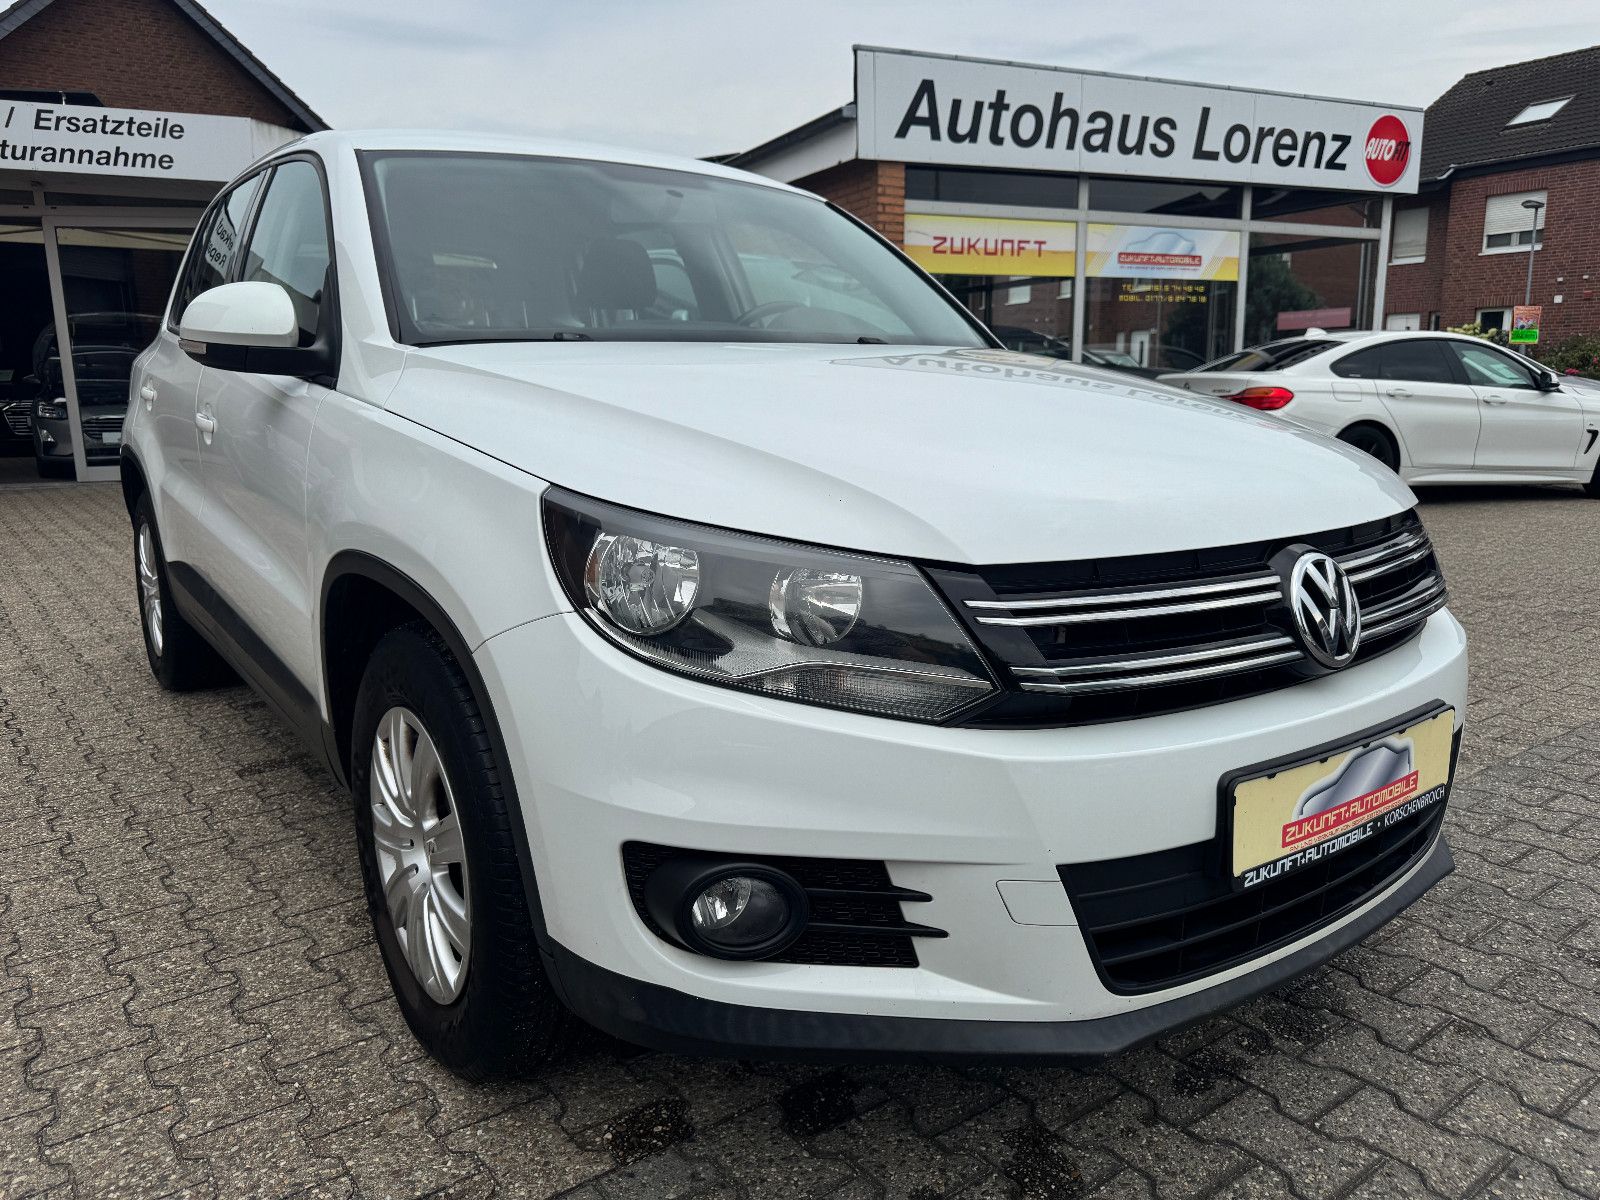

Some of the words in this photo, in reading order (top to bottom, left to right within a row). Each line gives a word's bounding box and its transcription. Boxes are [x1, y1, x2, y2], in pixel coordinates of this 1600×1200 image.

[34, 108, 185, 140] Ersatzteile
[894, 78, 1177, 158] Autohaus
[1192, 106, 1352, 171] Lorenz
[932, 236, 1047, 258] ZUKUNFT
[1384, 786, 1446, 828] KORSCHENBROICH
